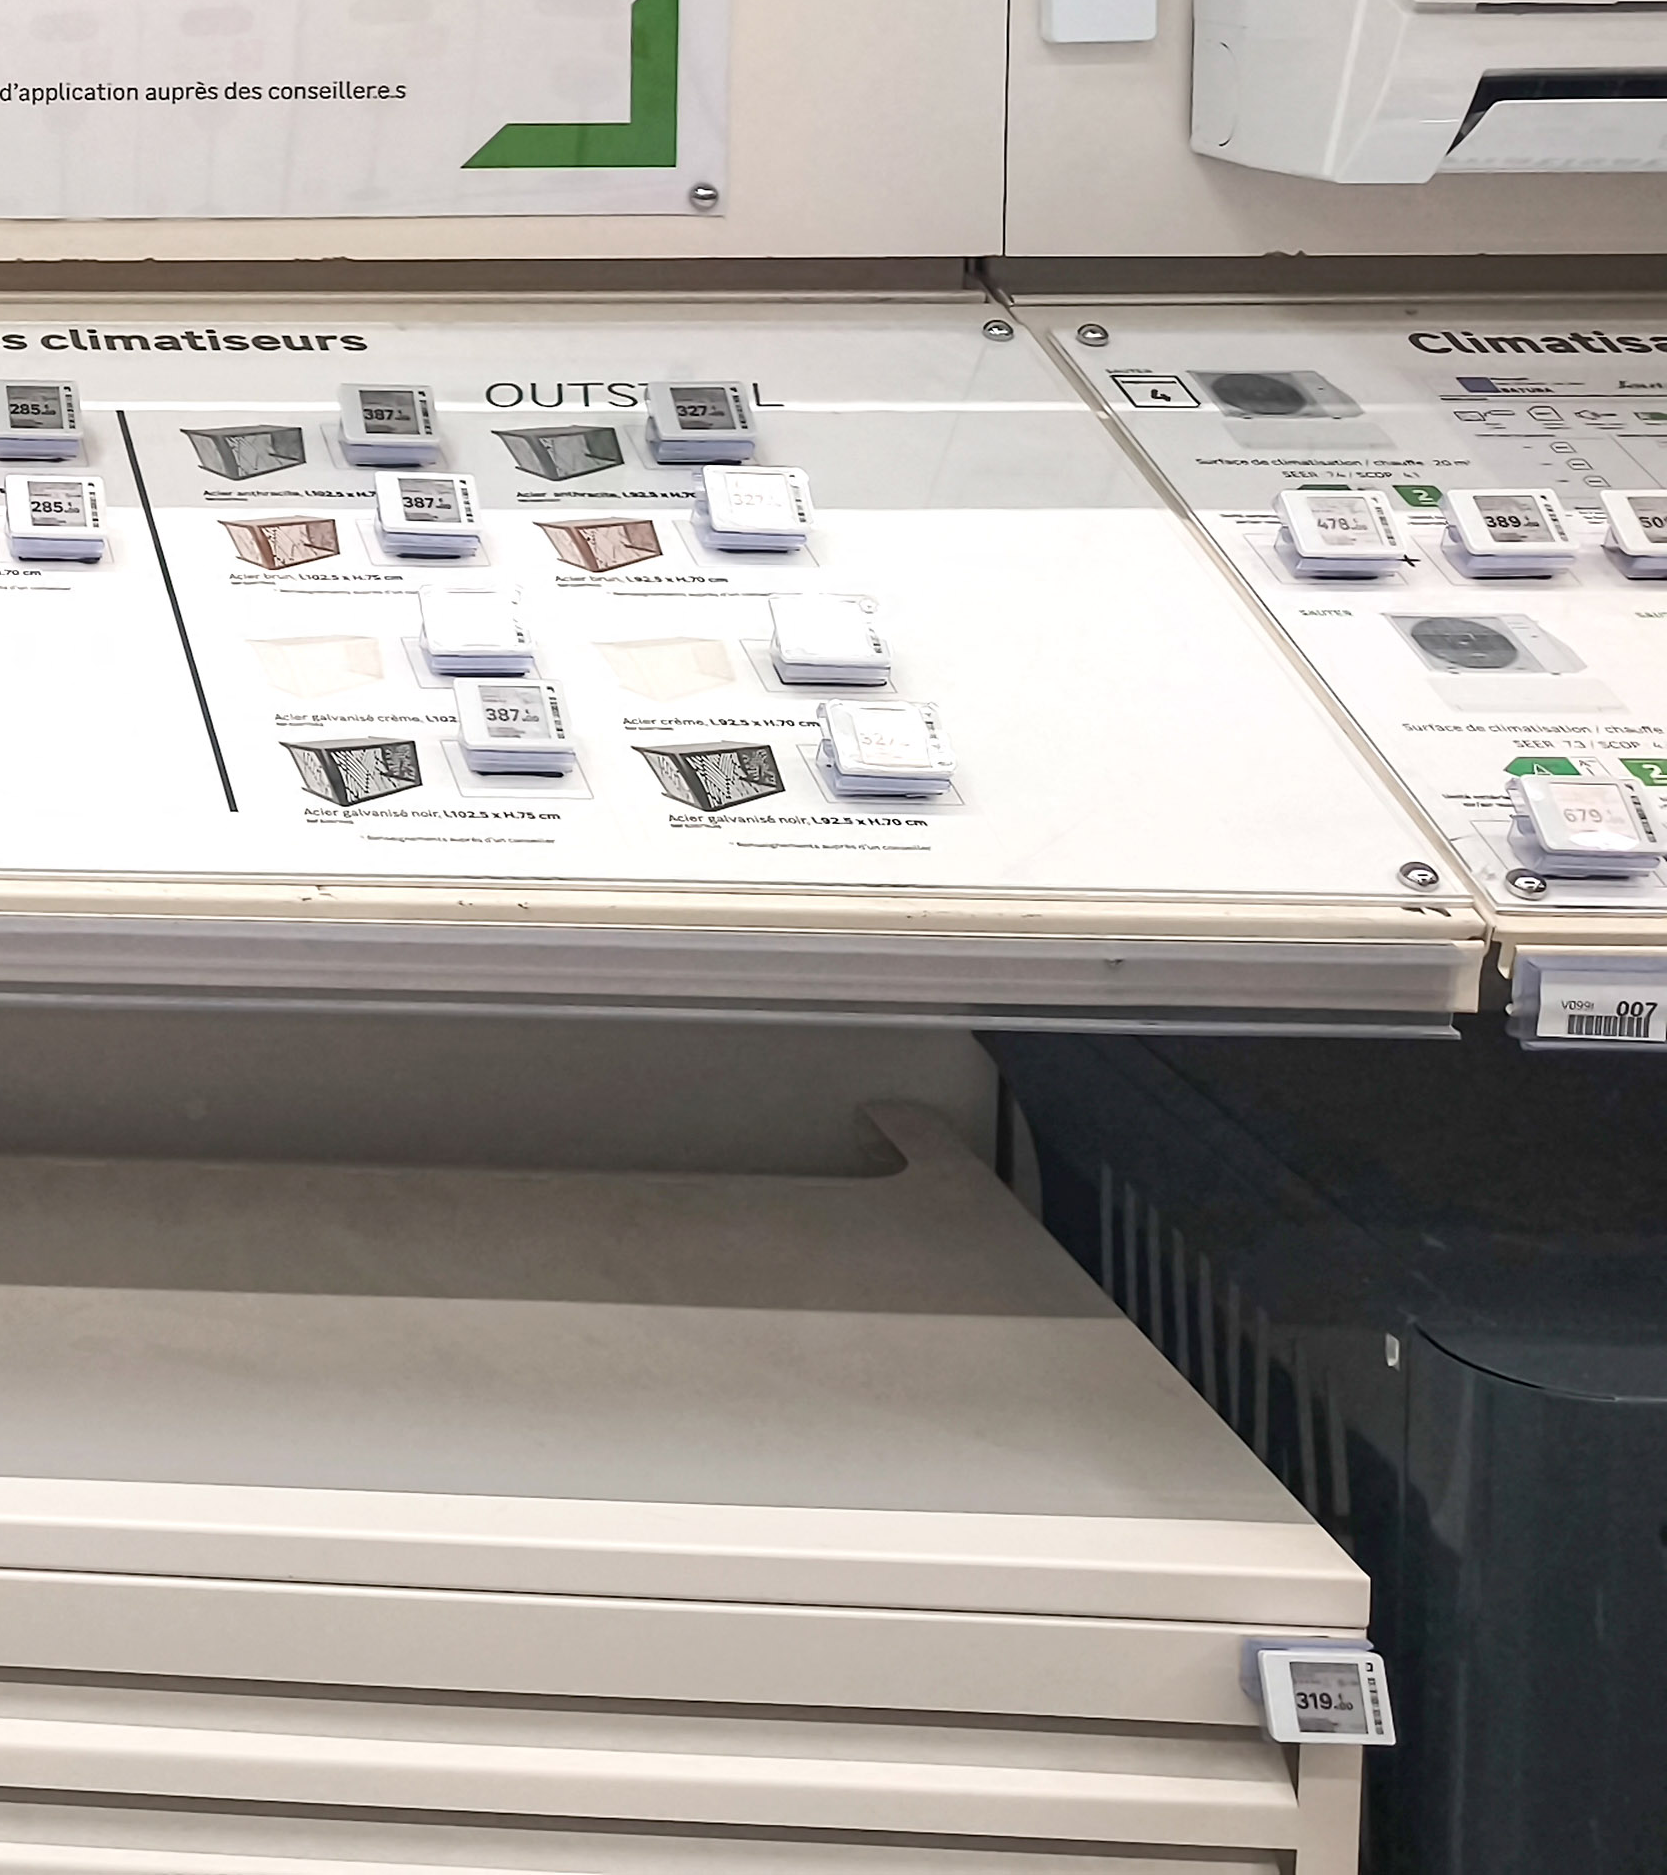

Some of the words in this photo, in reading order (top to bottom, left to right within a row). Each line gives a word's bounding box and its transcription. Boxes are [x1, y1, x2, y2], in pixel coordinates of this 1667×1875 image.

[0, 82, 139, 105] d’application
[145, 81, 219, 105] auprès
[225, 81, 263, 100] des
[40, 329, 369, 353] climatiseurs
[1616, 1000, 1657, 1018] 007
